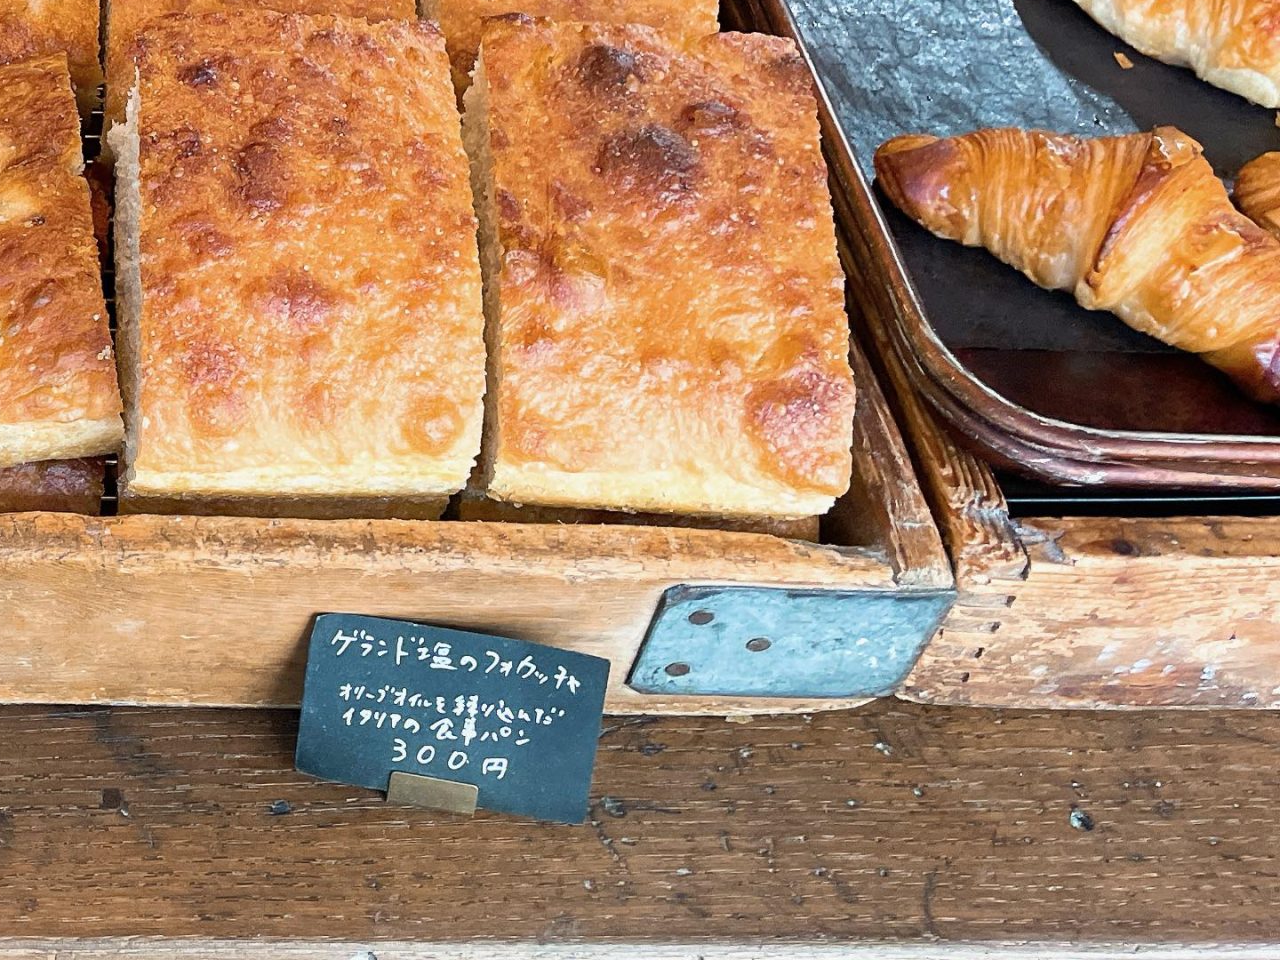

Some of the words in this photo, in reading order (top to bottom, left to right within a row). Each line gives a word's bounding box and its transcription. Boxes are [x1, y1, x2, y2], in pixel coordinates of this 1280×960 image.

[331, 628, 581, 695] ゲランド塩のフォカッチャ
[338, 683, 565, 726] オリーブオイルを練り込んだ
[341, 706, 531, 746] イタリアの食事パン
[391, 738, 509, 780] 300円
